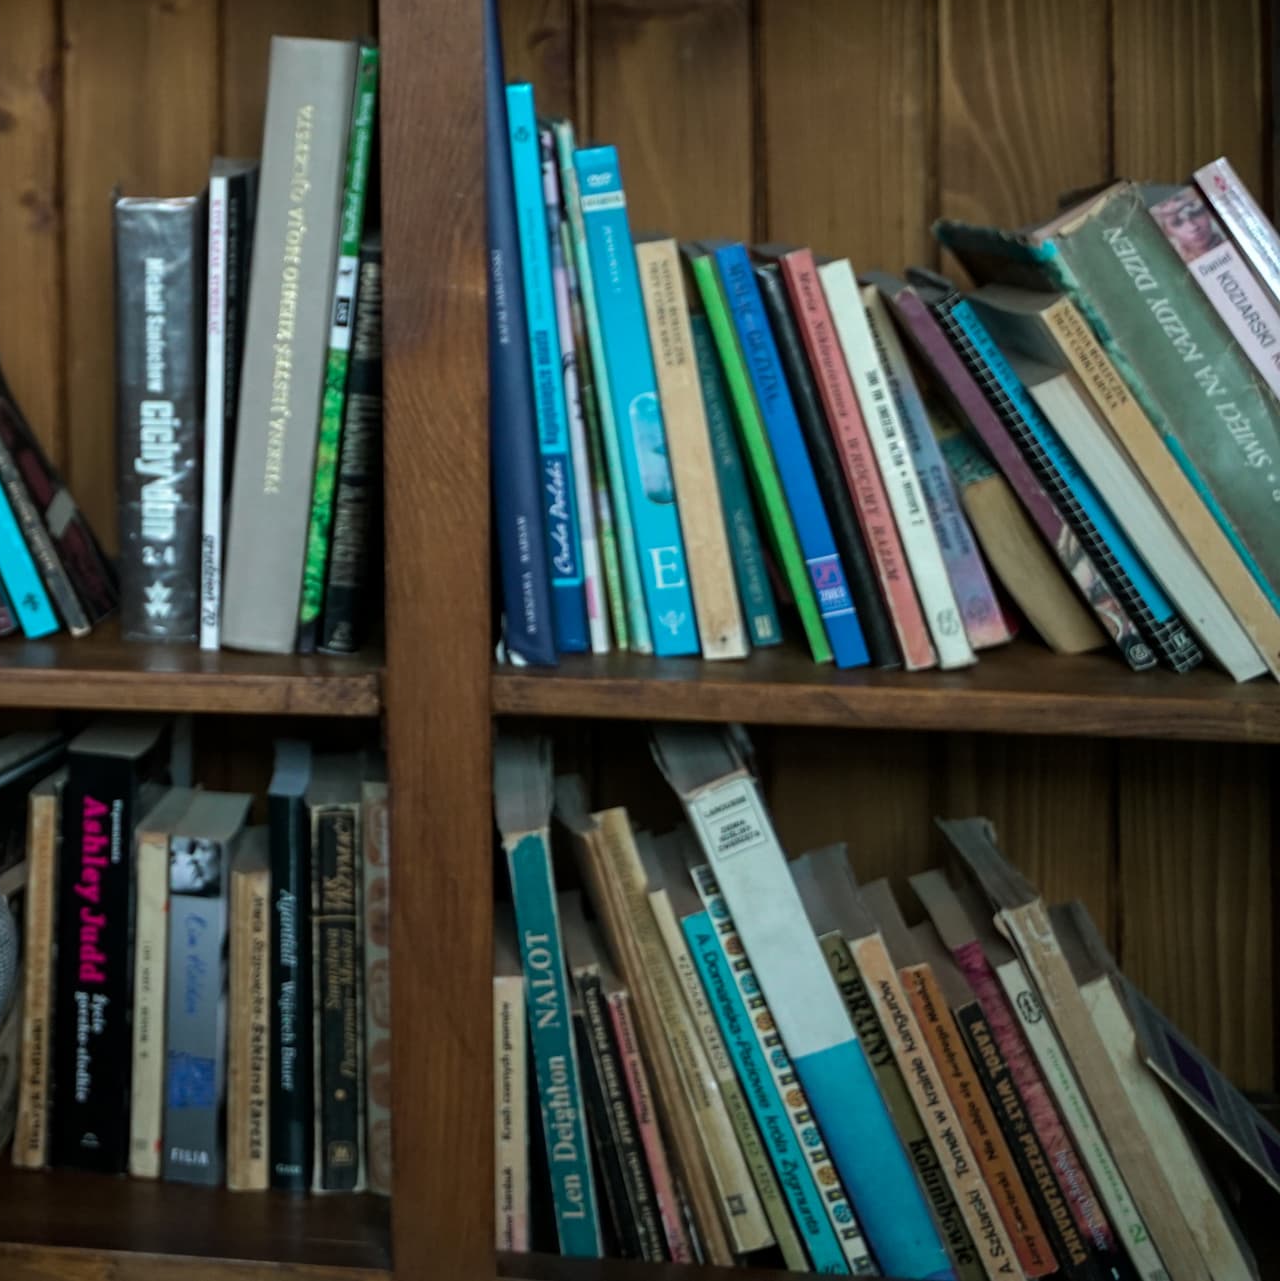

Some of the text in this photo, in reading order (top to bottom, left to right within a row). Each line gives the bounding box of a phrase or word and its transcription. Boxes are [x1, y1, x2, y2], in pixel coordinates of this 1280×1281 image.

[144, 257, 164, 311] Michaił
[260, 103, 320, 494] PIĘKNA JESTEŚ ZIEMIO MOJA OJCZYSTA
[1199, 250, 1233, 278] Daniel
[1215, 267, 1276, 353] KOZIARSKI
[1051, 311, 1074, 340] TRZY
[1098, 220, 1275, 475] ŚWIĘCI NA KAŻDY DZIEŃ
[133, 399, 181, 542] cichy don
[796, 269, 821, 313] Maria
[844, 435, 883, 517] WRÓCIMY
[871, 522, 901, 581] RAZEM
[543, 458, 576, 574] Cuda Polski
[203, 606, 215, 627] 70
[515, 515, 539, 633] WARSZAWA WARSAW
[73, 795, 109, 982] Ashley Judd
[72, 991, 90, 1101] gorzko-słodkie
[89, 993, 109, 1033] Życie
[277, 980, 296, 1091] Wojciech Bauer
[694, 931, 711, 951] A.
[763, 1112, 791, 1155] króla
[26, 1091, 42, 1150] Henryk
[523, 927, 585, 1221] Len Deighton NALOT
[598, 1052, 621, 1097] PRZED
[611, 1099, 634, 1145] JUTRO
[838, 976, 979, 1268] BRATNY Kolumbowie
[873, 976, 1014, 1276] A. Szklarski Tomek w krainie kangurów
[956, 1079, 974, 1099] się
[170, 1146, 210, 1166] FILIA
[966, 1018, 1007, 1078] KAROL
[993, 1077, 1027, 1123] WILT
[1014, 1131, 1091, 1266] PRZEKŁADANKA
[981, 1138, 999, 1161] Nie
[1020, 1231, 1046, 1267] Jerzy
